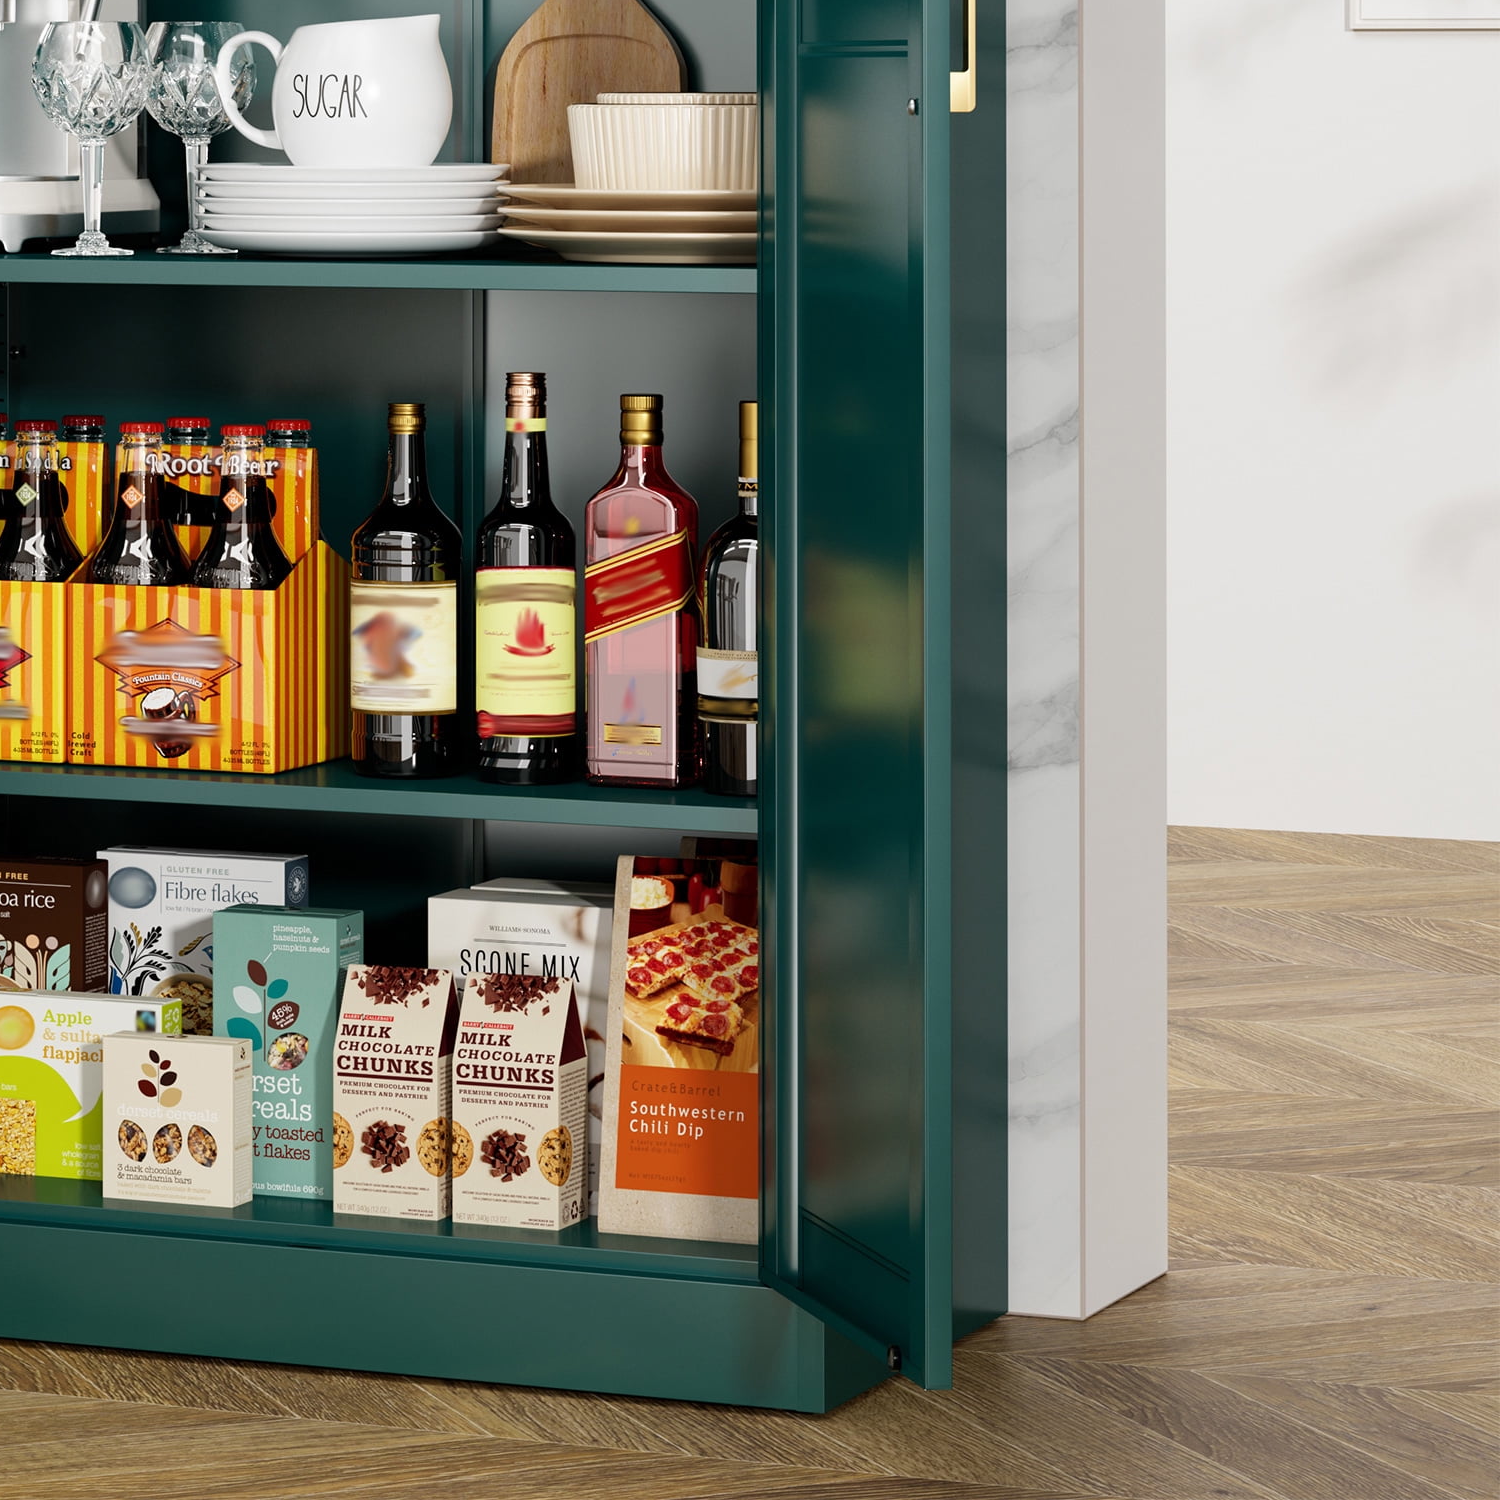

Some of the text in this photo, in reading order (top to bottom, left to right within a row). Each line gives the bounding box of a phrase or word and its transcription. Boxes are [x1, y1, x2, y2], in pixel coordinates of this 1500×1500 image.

[292, 74, 368, 118] SUGAR
[146, 452, 213, 477] Root
[132, 672, 204, 689] Fountain Classics
[20, 738, 42, 746] BOTTLES
[71, 732, 90, 740] Cold
[70, 748, 92, 757] Craft
[5, 872, 29, 881] FREE
[166, 866, 230, 876] GLUTEN FREE
[24, 890, 56, 909] rice
[166, 882, 259, 904] Fibre flakes
[272, 924, 312, 934] pineapple,
[272, 933, 311, 943] hazelnuts
[272, 943, 330, 954] pumpkin seeds
[460, 948, 580, 983] SCONE MIX
[42, 1008, 92, 1026] Apple
[42, 1028, 102, 1044] & sulta
[340, 1024, 392, 1039] MILK
[460, 1032, 512, 1047] MILK
[338, 1040, 435, 1057] CHOCOLATE
[457, 1048, 556, 1065] CHOCOLATE
[337, 1055, 434, 1076] CHUNKS
[456, 1063, 554, 1084] CHUNKS
[0, 1082, 17, 1091] bars
[252, 1073, 302, 1095] rset
[340, 1080, 372, 1088] PREMIUM
[374, 1082, 415, 1091] CHOCOLATE
[632, 1080, 721, 1097] Crate&Barrel
[342, 1088, 377, 1097] DESSERTS
[395, 1092, 428, 1100] PASTRIES
[493, 1091, 536, 1100] CHOCOLATE
[252, 1098, 312, 1122] reals
[461, 1097, 497, 1105] DESSERTS
[515, 1101, 549, 1109] PASTRIES
[630, 1100, 745, 1122] Southwestern
[116, 1104, 219, 1122] dorset cereals
[265, 1124, 325, 1143] toasted
[629, 1119, 704, 1140] Chili Dip
[61, 1150, 99, 1160] wholegrain
[264, 1143, 310, 1161] flakes
[124, 1164, 143, 1173] dark
[144, 1165, 182, 1176] chocolate
[117, 1172, 192, 1185] & macadamia bars
[266, 1182, 301, 1193] bowlfuls
[302, 1184, 324, 1195] 690g
